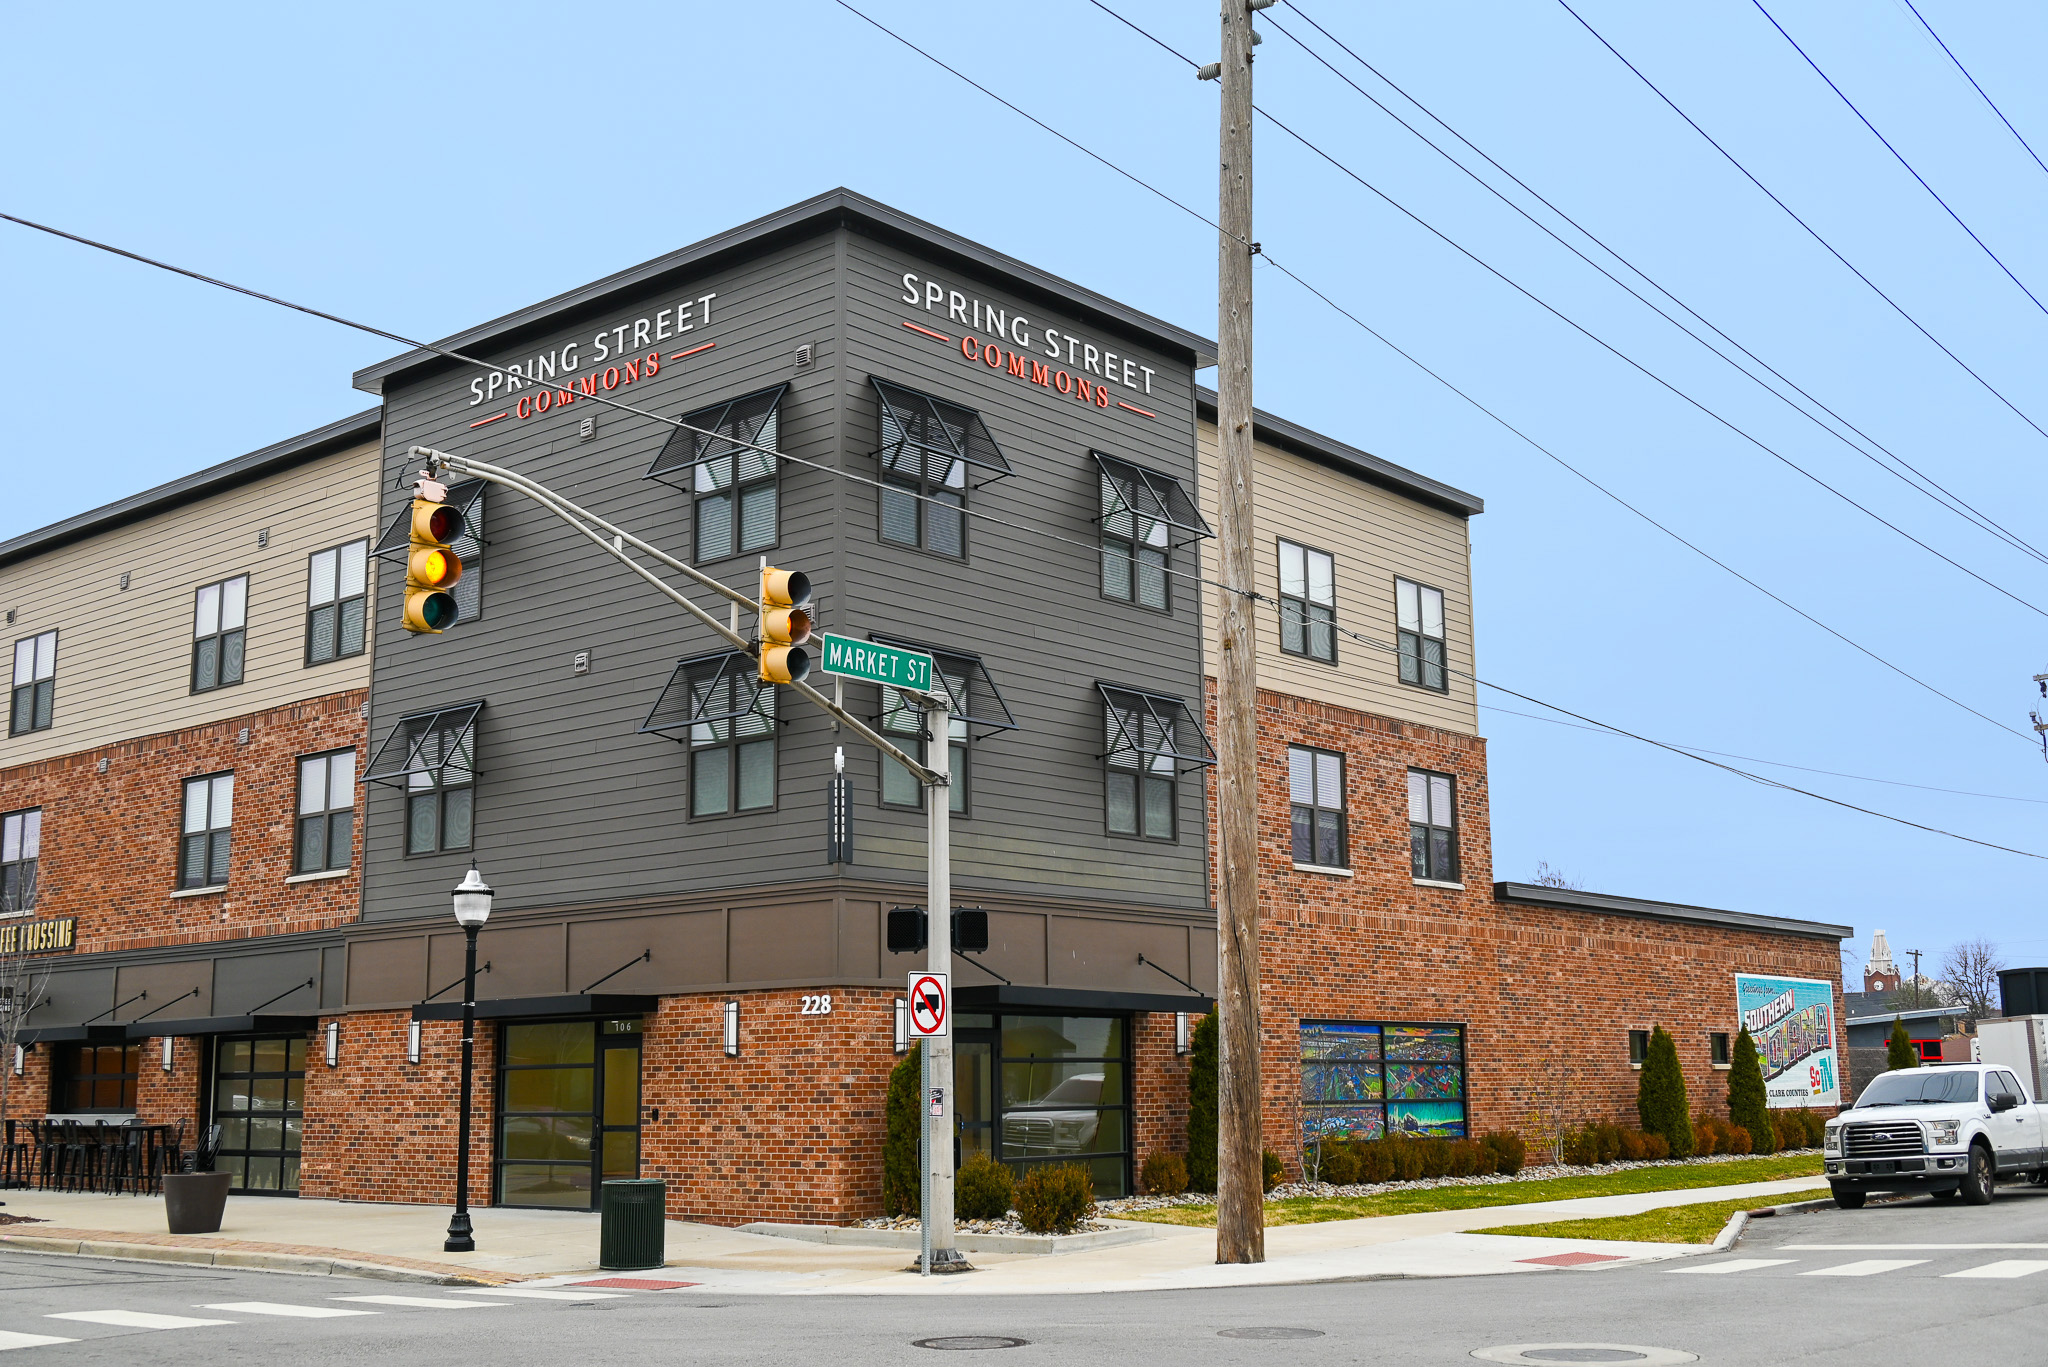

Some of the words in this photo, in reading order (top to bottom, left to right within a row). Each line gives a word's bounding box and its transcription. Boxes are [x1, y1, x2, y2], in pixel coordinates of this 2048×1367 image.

[469, 342, 578, 406] SPRING
[593, 292, 717, 362] STREET
[902, 273, 1029, 347] SPRING
[1044, 328, 1155, 394] STREET
[516, 352, 660, 419] COMMONS
[962, 336, 1109, 408] COMMONS
[829, 642, 899, 678] MARKET
[907, 658, 927, 684] ST
[615, 1022, 632, 1032] 106
[801, 994, 832, 1015] 228
[1744, 988, 1795, 1033] SOUTHERN
[1750, 1003, 1832, 1082] NDIANA
[1769, 1089, 1786, 1097] CLARK
[1786, 1089, 1809, 1097] COUNTIES
